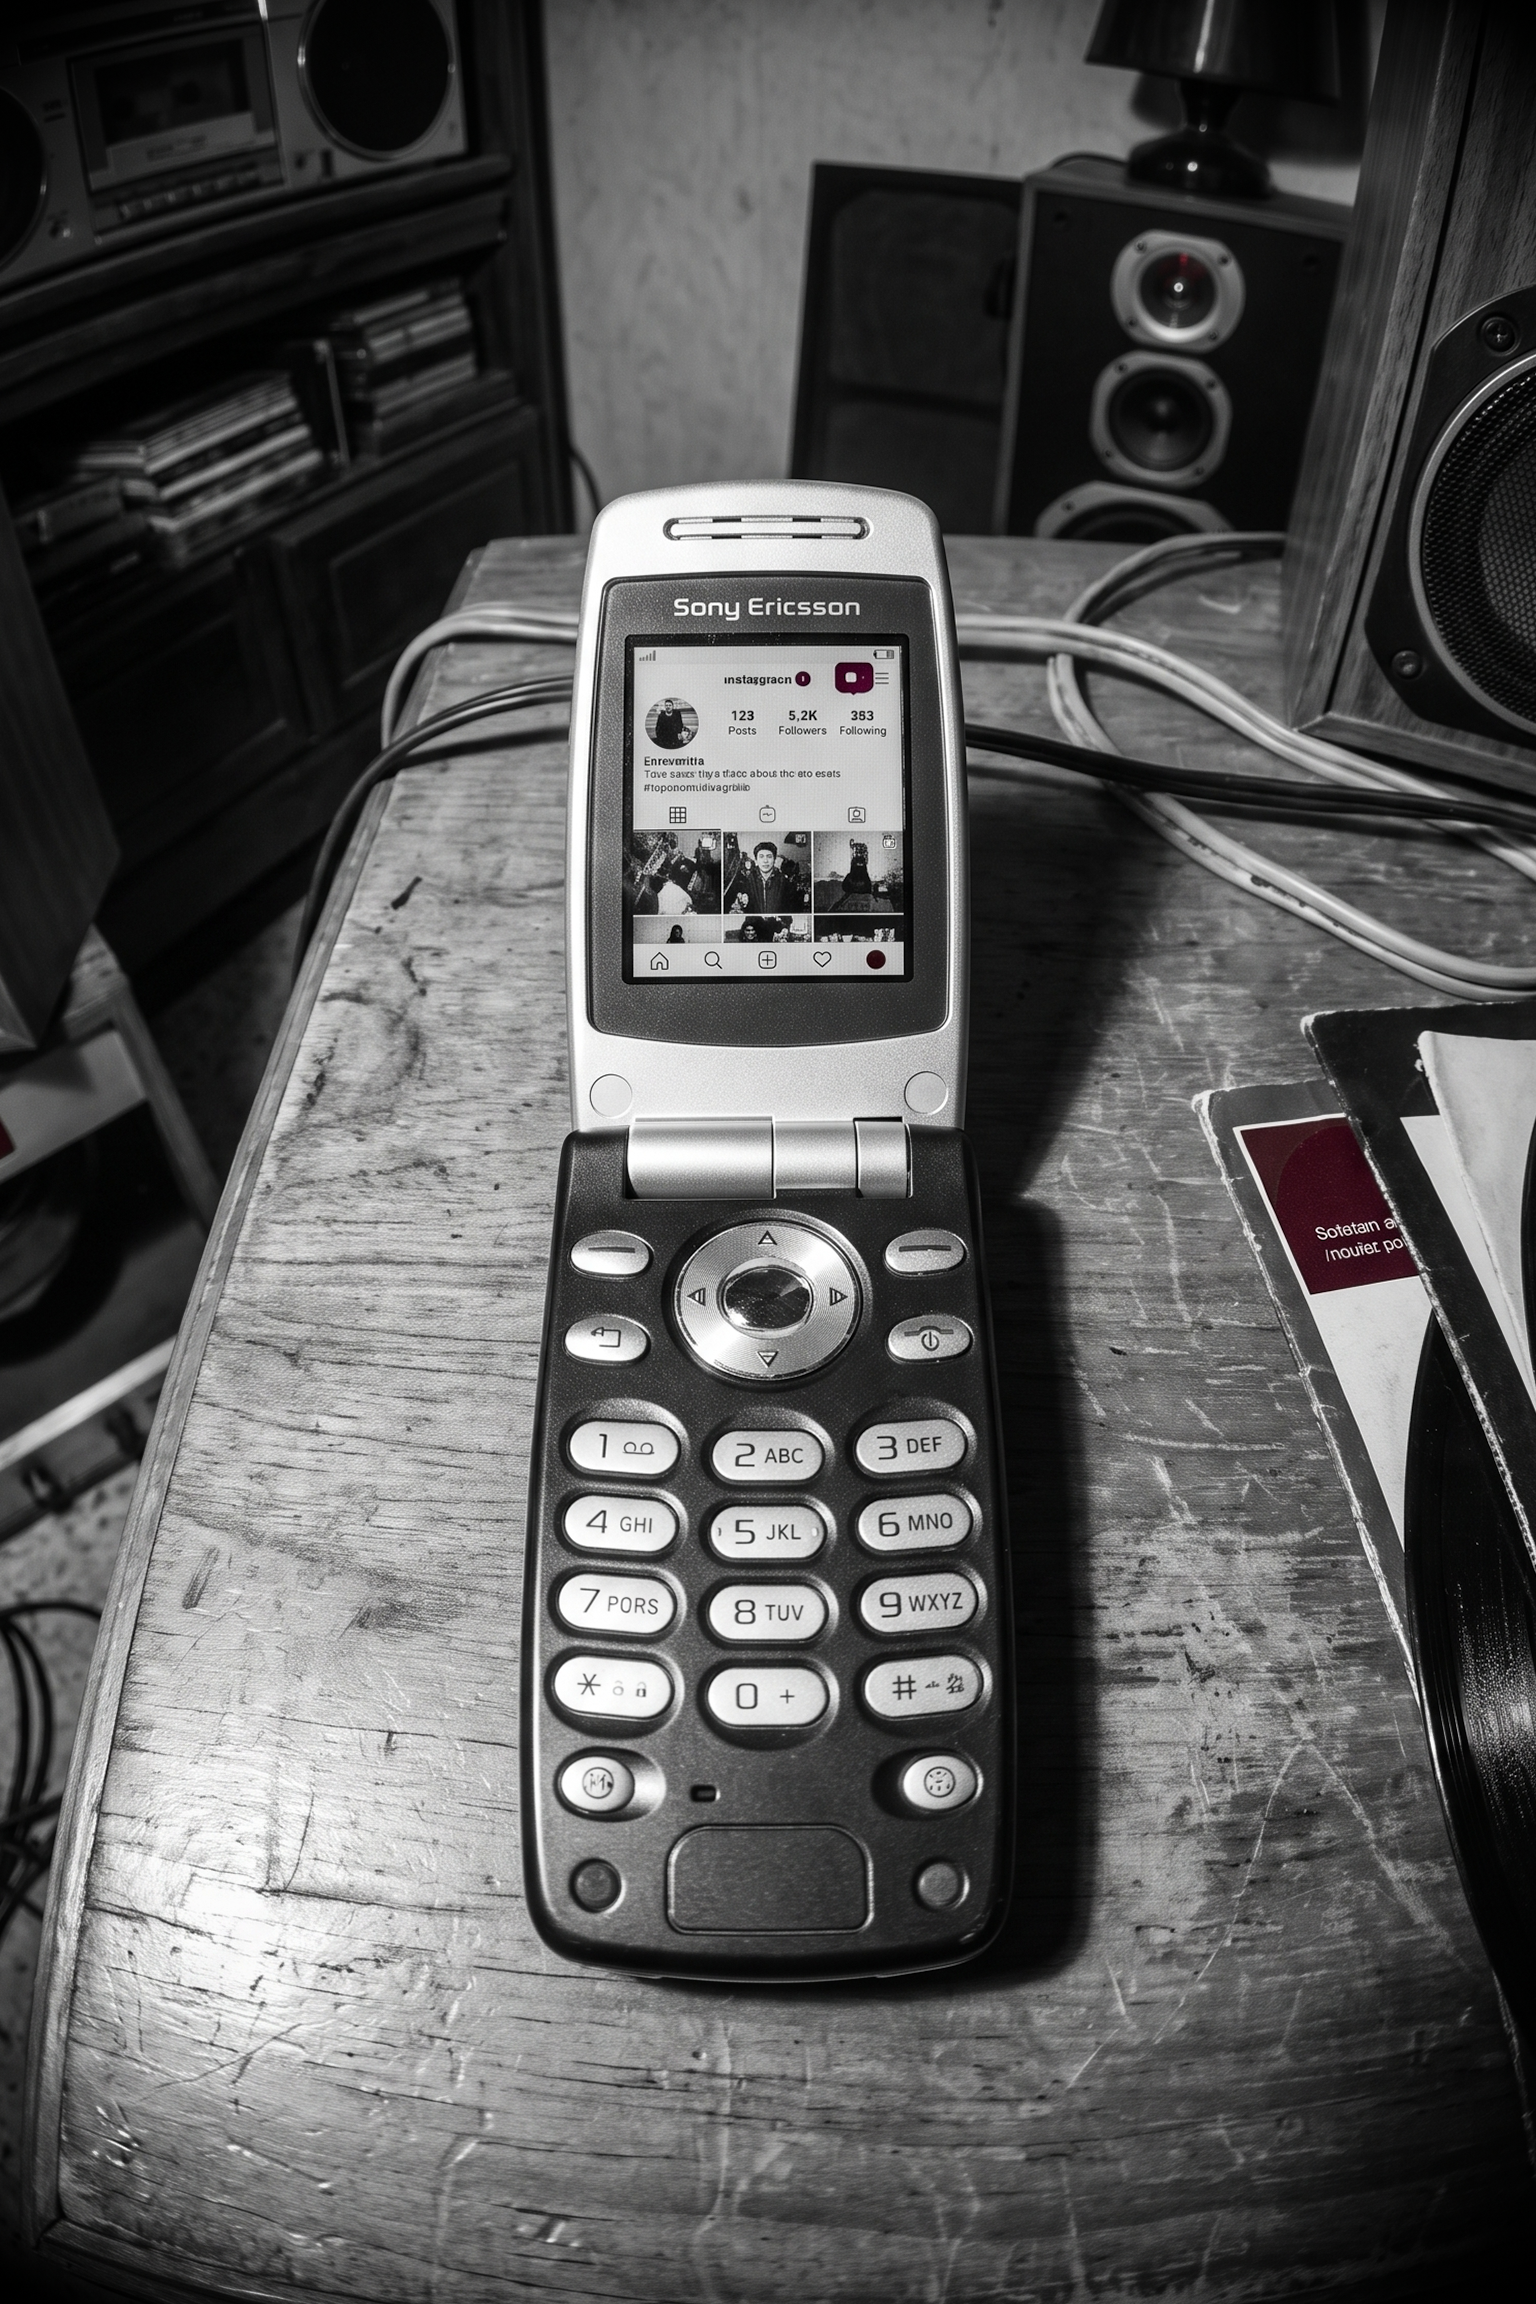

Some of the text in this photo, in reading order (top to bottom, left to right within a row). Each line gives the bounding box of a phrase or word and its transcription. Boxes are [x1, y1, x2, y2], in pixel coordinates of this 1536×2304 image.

[673, 598, 861, 621] Sony Ericsson
[731, 710, 755, 721] 123
[728, 726, 757, 736] Posts
[778, 726, 827, 736] Followers
[839, 726, 887, 737] Following
[599, 1433, 608, 1458] 1
[734, 1442, 804, 1467] 2 ABC
[876, 1435, 942, 1460] 3 DEF
[586, 1509, 653, 1534] 4 GHI
[734, 1519, 801, 1544] 5 JKL
[878, 1512, 953, 1537] 6 MNO
[579, 1587, 601, 1613] 7
[734, 1599, 804, 1625] 8 TUV
[879, 1592, 963, 1618] 9 WXYZ
